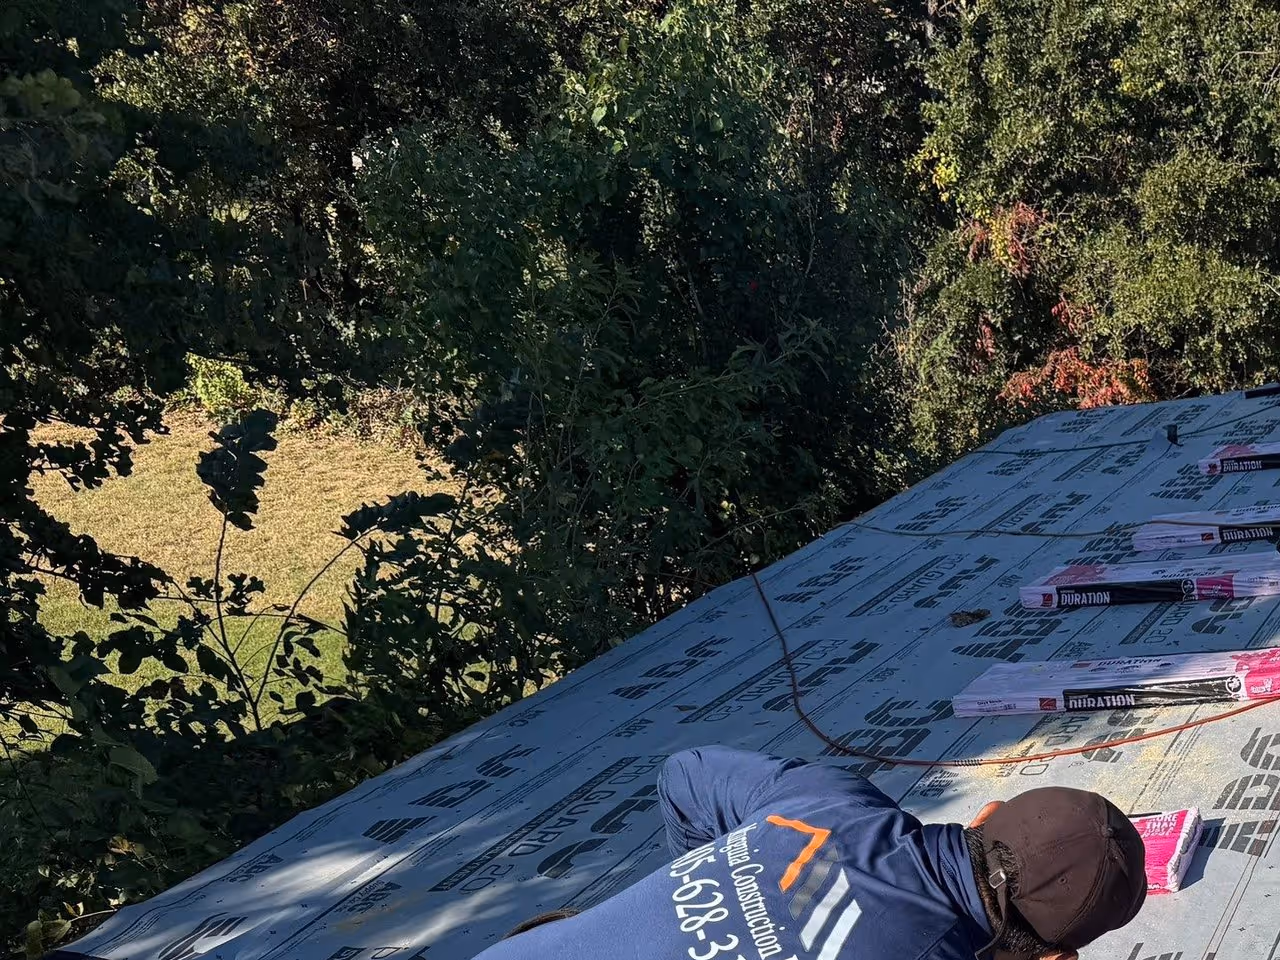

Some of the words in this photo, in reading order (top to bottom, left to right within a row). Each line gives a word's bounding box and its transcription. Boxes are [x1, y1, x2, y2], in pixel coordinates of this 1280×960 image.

[1223, 460, 1263, 472] DURATION
[1223, 527, 1274, 541] DURATION
[1060, 591, 1111, 606] DURATION
[1069, 693, 1137, 710] DURATION
[508, 789, 616, 858] GUARD
[459, 864, 515, 894] 20
[731, 863, 786, 960] Construction
